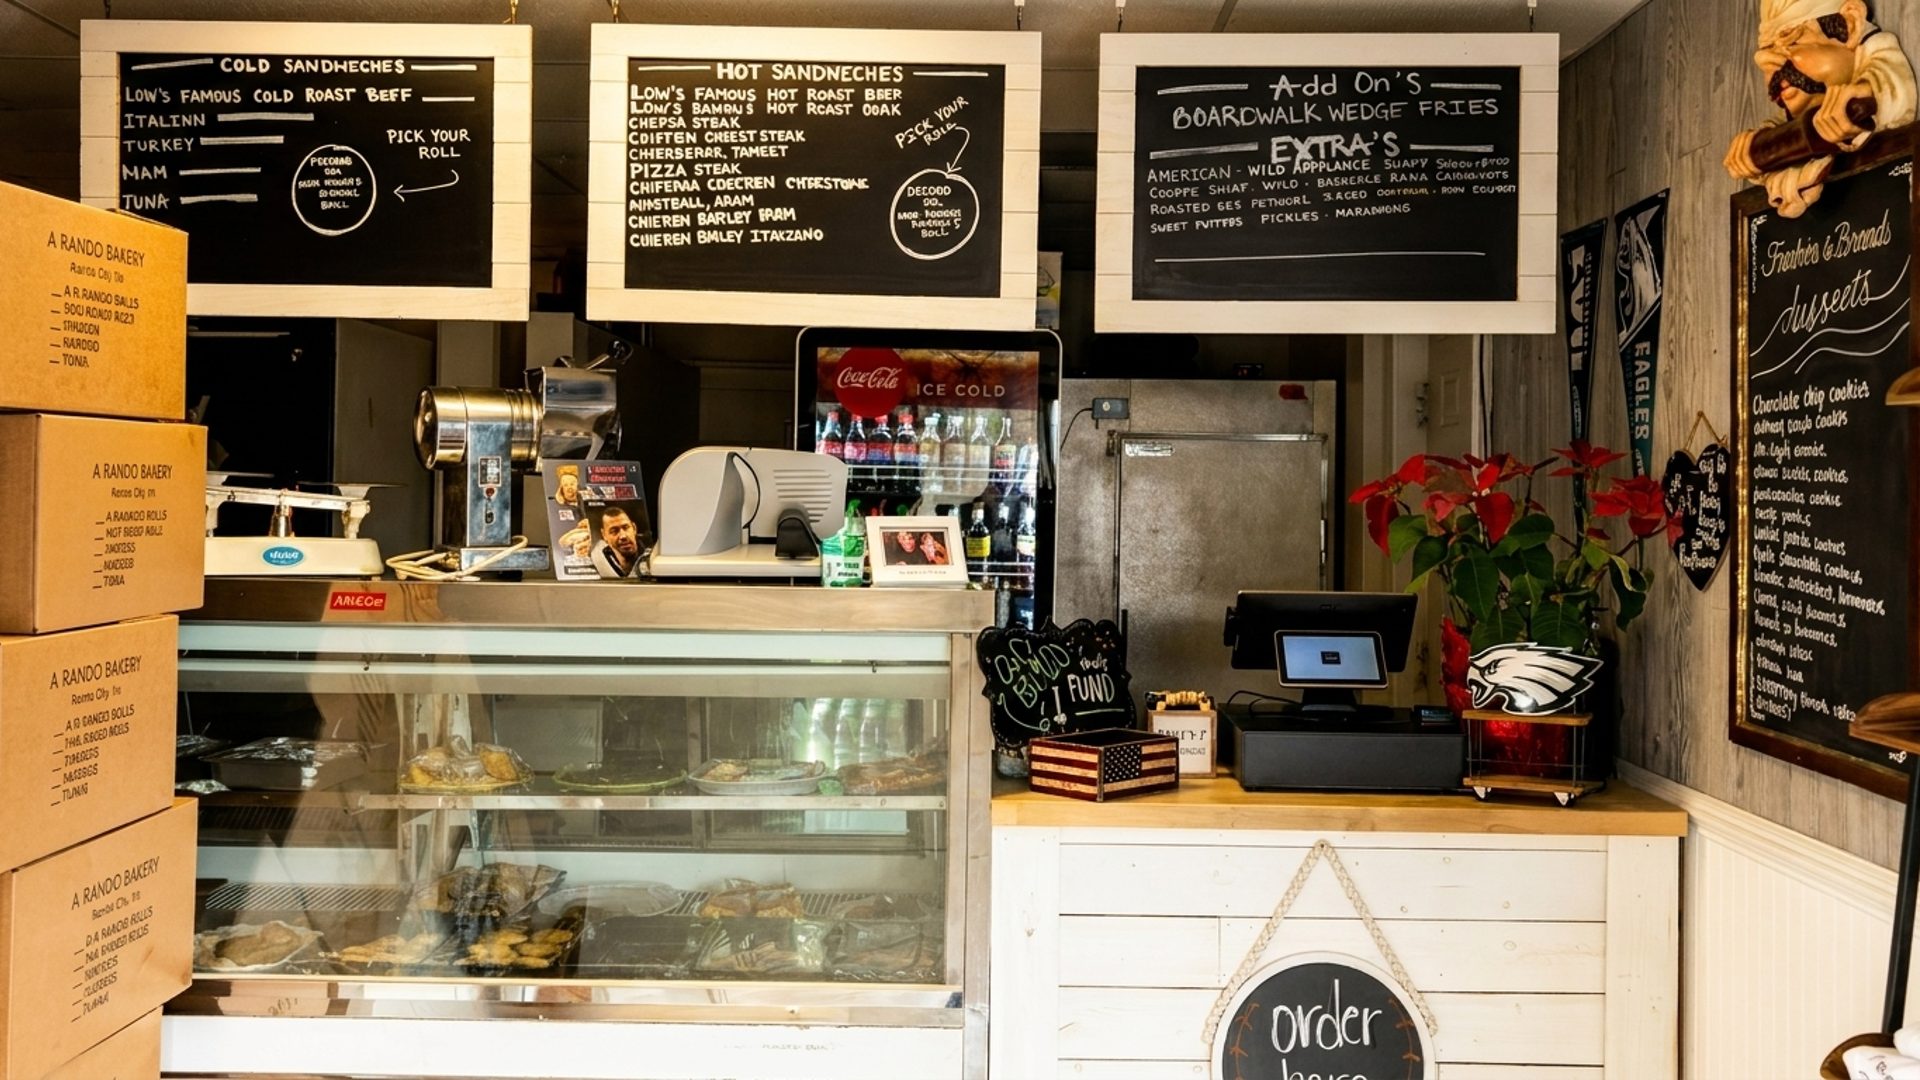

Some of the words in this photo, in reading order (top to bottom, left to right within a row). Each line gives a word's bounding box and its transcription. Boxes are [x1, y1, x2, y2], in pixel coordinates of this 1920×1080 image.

[220, 58, 270, 72] COLD
[717, 62, 762, 80] HOT
[694, 87, 757, 102] FAMOUS
[767, 88, 798, 101] HOT
[806, 88, 855, 101] ROAST
[1269, 73, 1337, 101] Add
[180, 88, 242, 104] FAMOUS
[254, 88, 294, 104] COLD
[306, 88, 356, 102] ROAST
[766, 102, 798, 114] HOT
[1328, 102, 1408, 122] WEDGE
[1418, 98, 1499, 116] FRIES
[692, 116, 742, 129] STEAK
[386, 128, 426, 144] PICK
[430, 128, 472, 143] YOUR
[122, 137, 194, 152] TURKEY
[418, 146, 461, 160] ROLL
[122, 164, 168, 180] MAM
[630, 163, 688, 179] PIZZA
[694, 163, 742, 176] STEAK
[1146, 164, 1231, 183] AMERICAN
[1248, 164, 1286, 176] WILD
[122, 193, 170, 210] TUNA
[1150, 202, 1211, 215] ROASTED
[1260, 211, 1320, 225] PICKLES
[47, 231, 57, 248] A
[60, 233, 104, 258] RANDO
[106, 244, 145, 268] BAKERY
[916, 383, 946, 396] ICE
[955, 384, 1006, 398] COLD
[1634, 340, 1651, 440] EAGLES
[92, 463, 100, 479] A
[50, 672, 58, 690] A
[62, 663, 103, 688] RANDO
[105, 655, 142, 678] BAKERY
[1067, 673, 1115, 704] FUND
[71, 892, 80, 910] A
[82, 874, 122, 905] RANDO
[124, 856, 160, 888] BAKERY
[1271, 978, 1383, 1054] order
